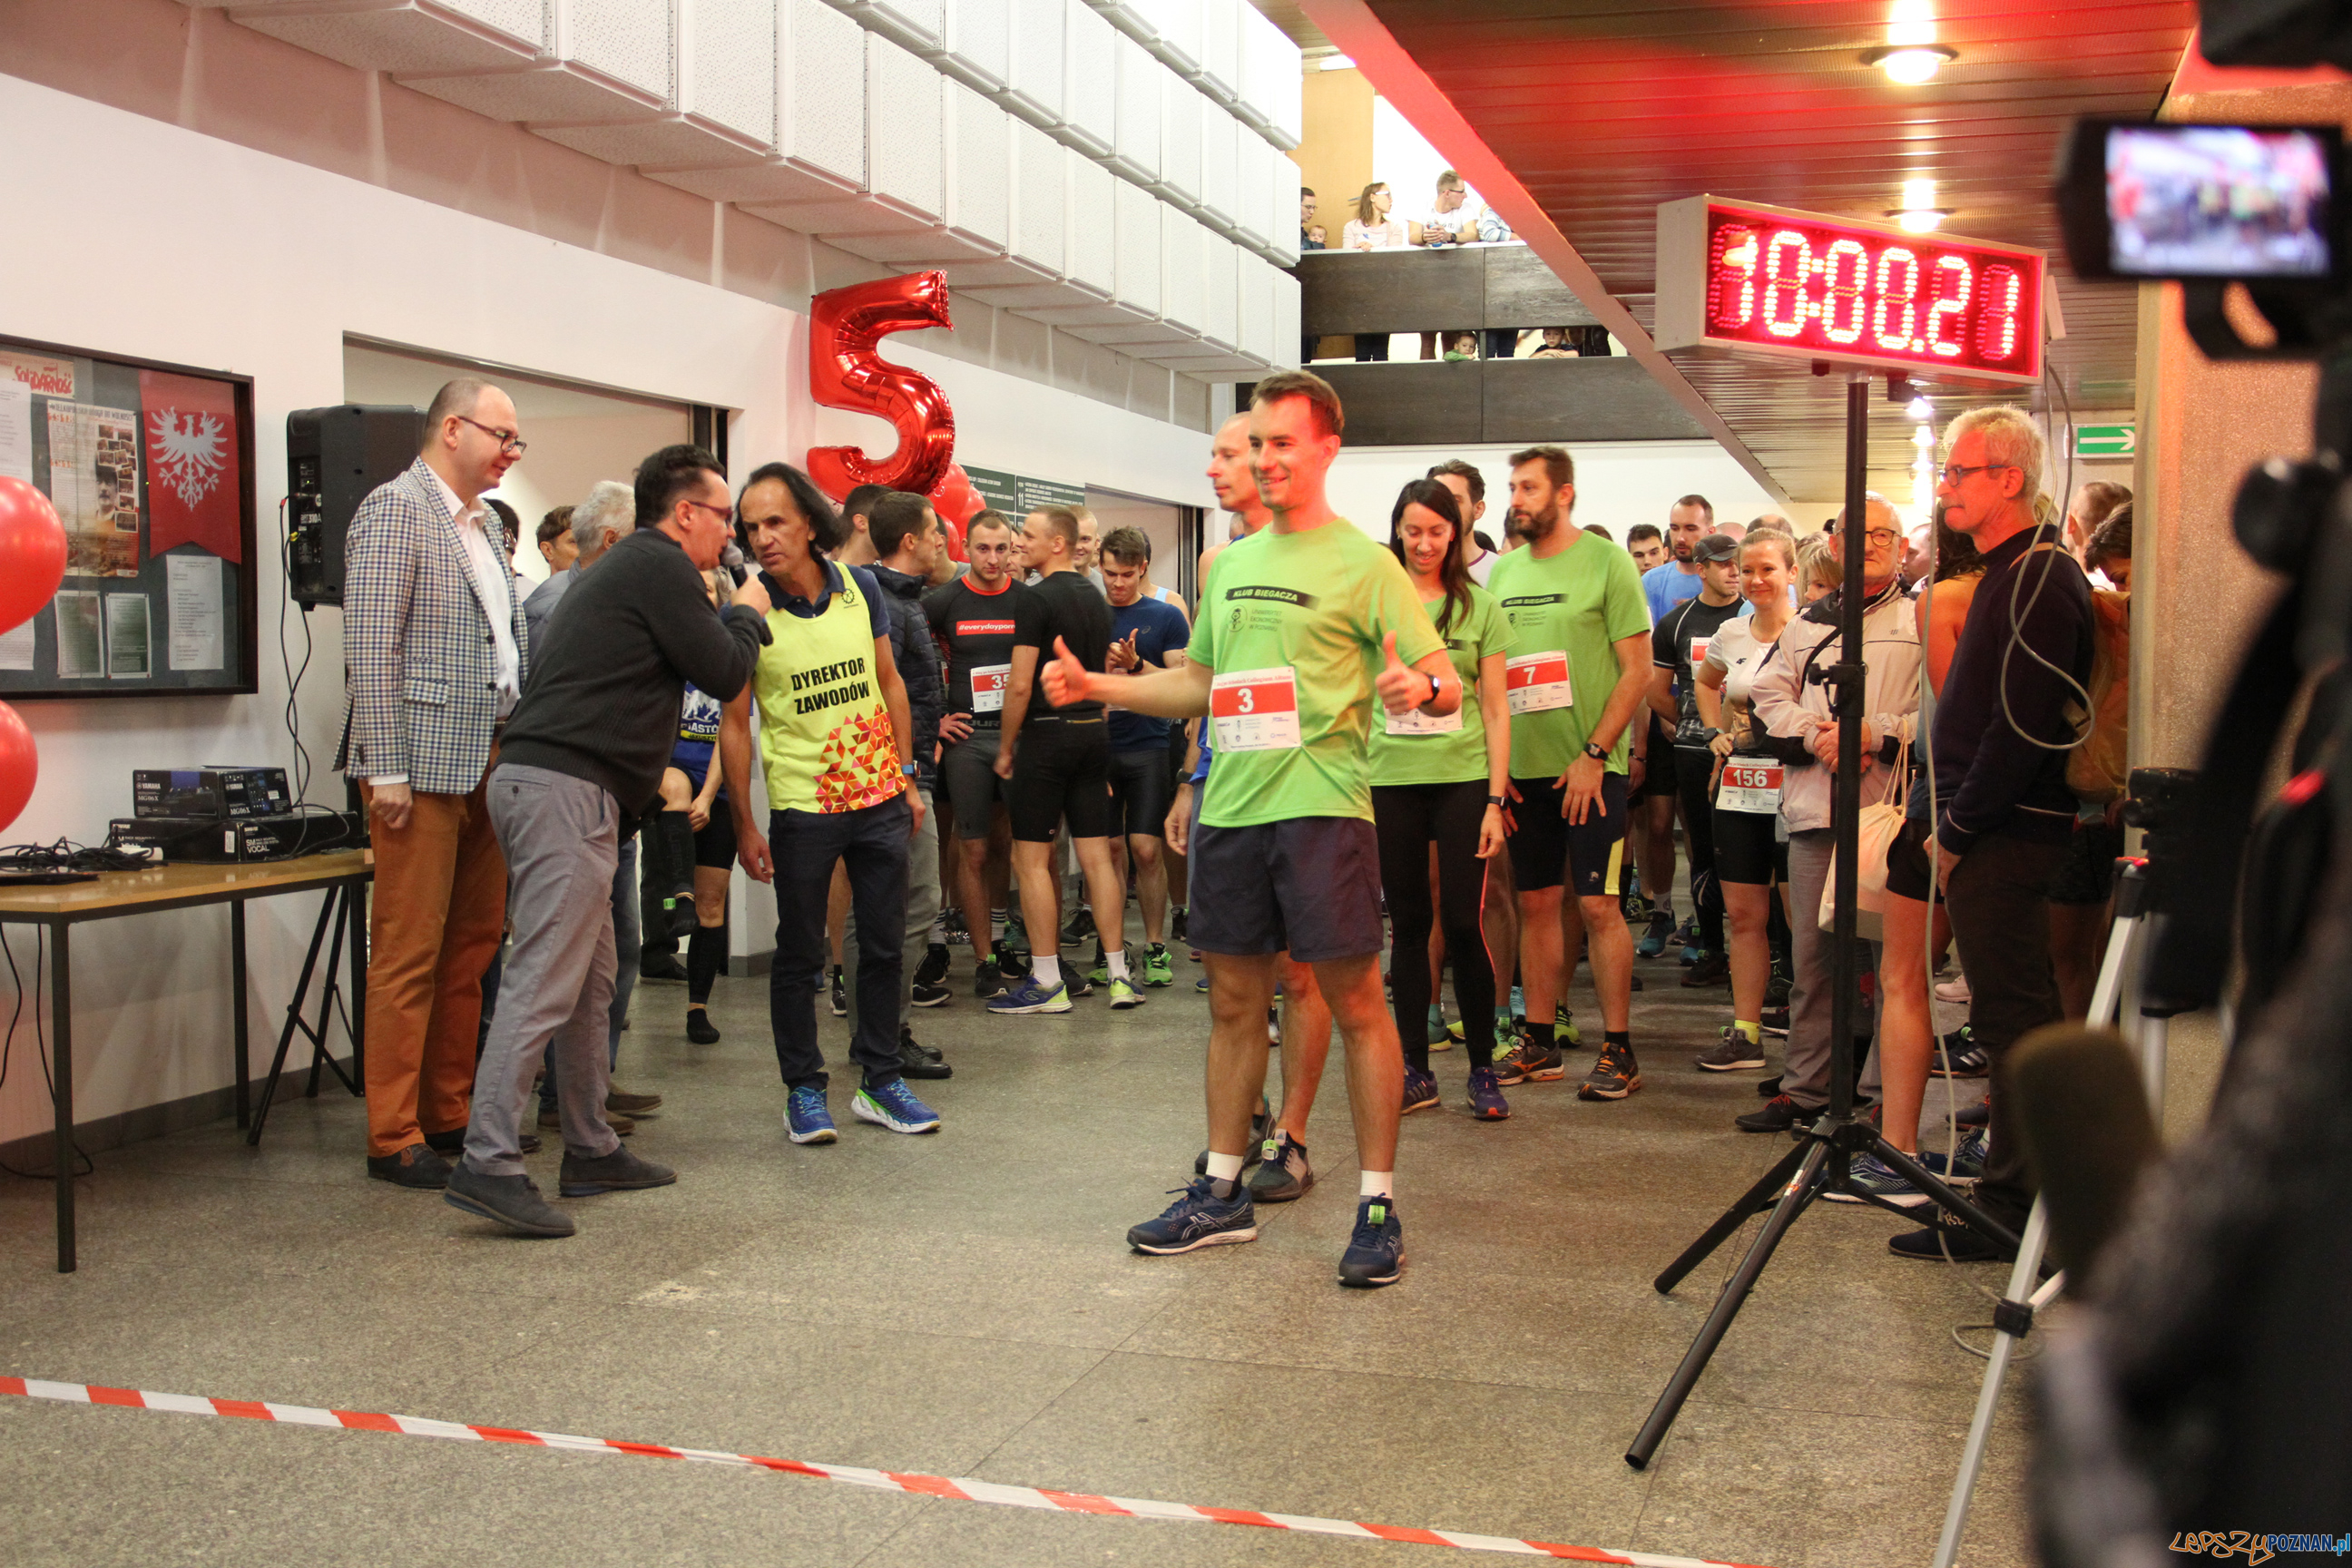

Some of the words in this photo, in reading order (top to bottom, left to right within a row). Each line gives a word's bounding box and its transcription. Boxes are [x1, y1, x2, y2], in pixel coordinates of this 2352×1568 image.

[807, 270, 956, 505] 5
[1233, 588, 1253, 598] KLUB
[1254, 589, 1298, 602] BIEGACZA
[790, 657, 866, 691] DYREKTOR
[1523, 666, 1536, 684] 7
[794, 681, 870, 715] ZAWODÓW
[1237, 687, 1254, 713] 3
[1733, 769, 1768, 787] 156
[247, 845, 270, 853] VOCAL
